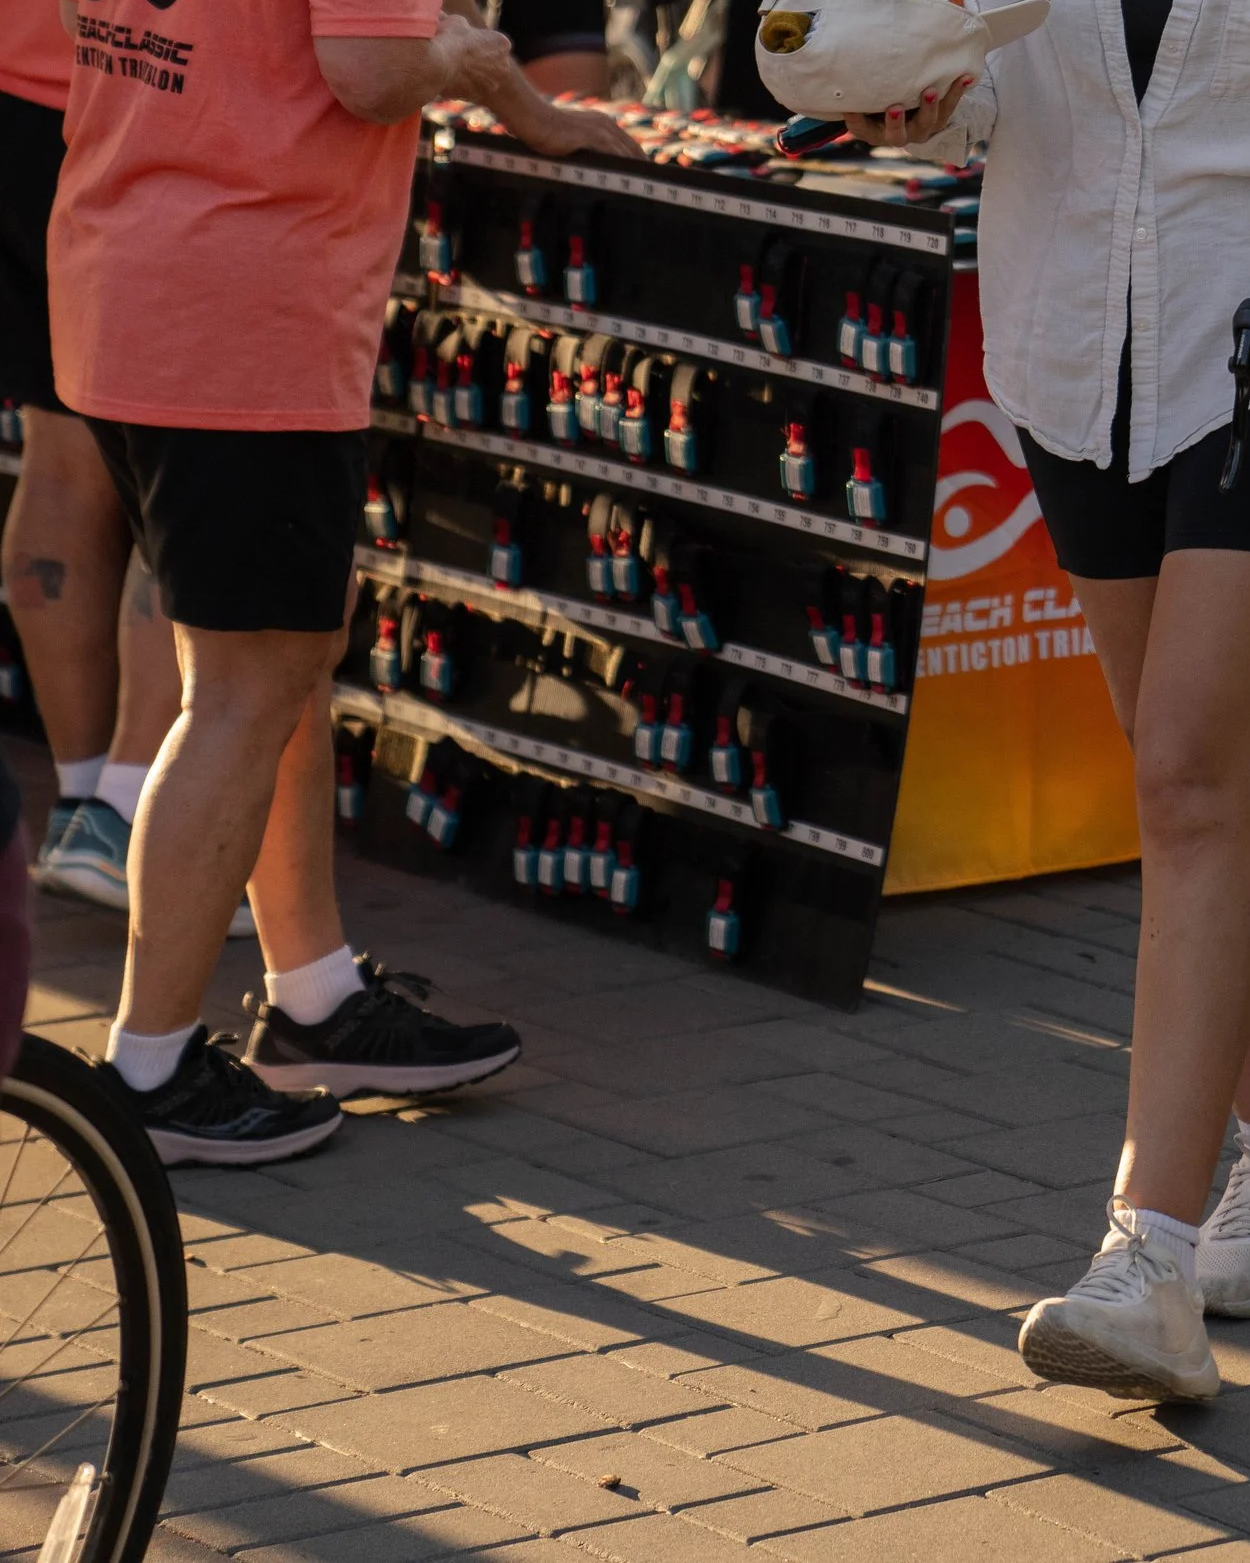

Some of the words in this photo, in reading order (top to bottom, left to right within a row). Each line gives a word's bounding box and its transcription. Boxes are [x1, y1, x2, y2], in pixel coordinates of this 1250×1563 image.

[714, 198, 725, 210] 712
[739, 203, 750, 215] 713
[765, 208, 777, 219] 714
[791, 212, 803, 225] 715
[818, 217, 830, 229] 716
[845, 221, 857, 233] 717
[872, 226, 885, 238] 718
[899, 231, 911, 243] 719
[926, 236, 939, 249] 720
[707, 343, 718, 355] 732
[733, 349, 744, 362] 733
[759, 355, 770, 367] 734
[785, 360, 797, 373] 735
[838, 373, 850, 386] 737
[890, 385, 901, 398] 739
[916, 391, 929, 404] 740
[722, 494, 733, 507] 753
[748, 501, 759, 514] 754
[774, 508, 786, 521] 755
[824, 521, 836, 535] 757
[904, 541, 916, 554] 760
[731, 648, 743, 661] 774
[755, 655, 767, 668] 775
[806, 670, 819, 683] 777
